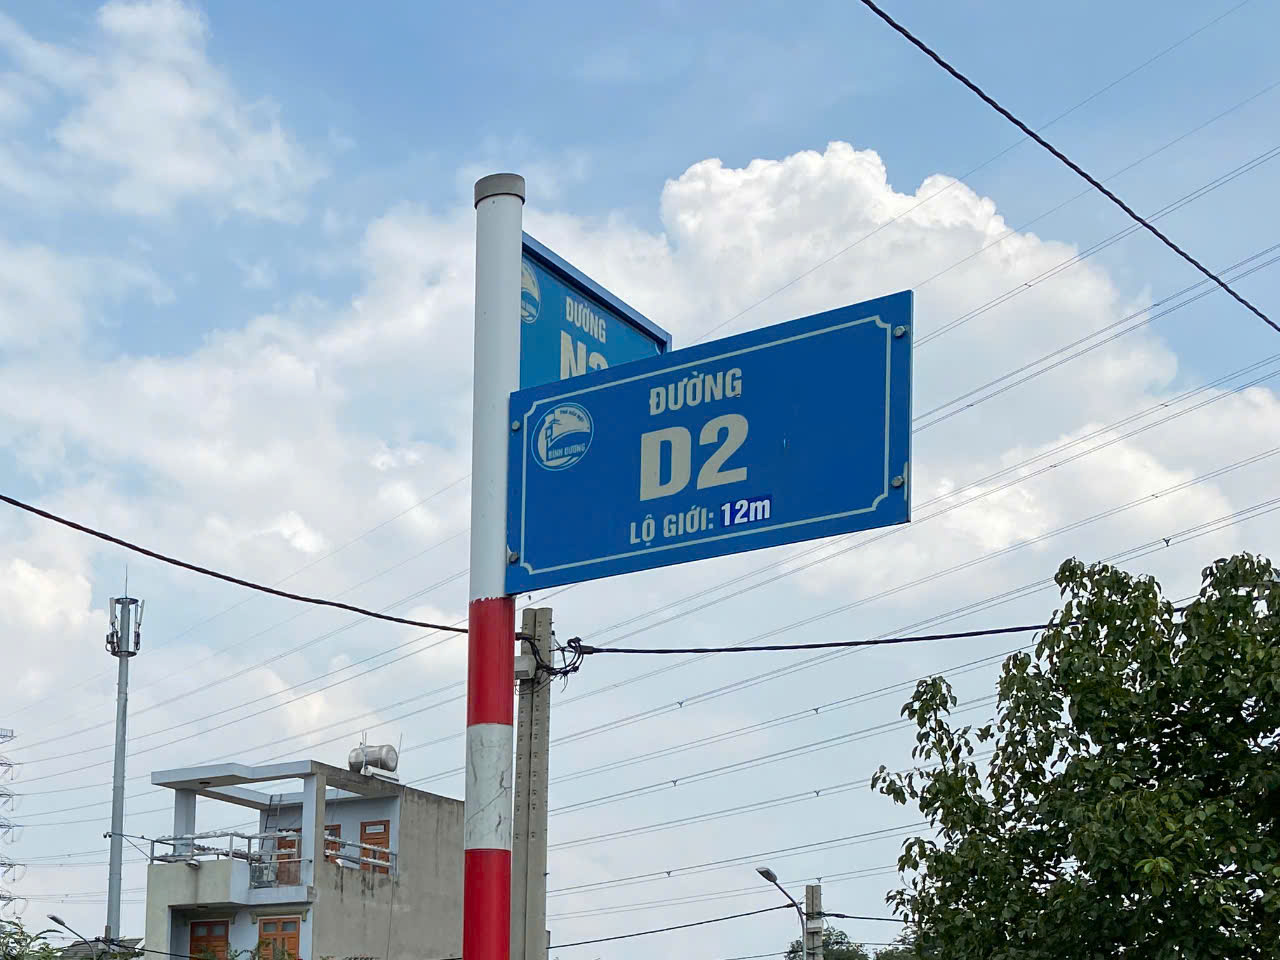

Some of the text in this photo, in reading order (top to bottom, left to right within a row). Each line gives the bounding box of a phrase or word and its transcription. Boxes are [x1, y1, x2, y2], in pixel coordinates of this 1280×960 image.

[649, 367, 742, 416] ĐƯỜNG
[640, 413, 749, 501] D2
[630, 499, 771, 546] LỘ GIỚI: 12m
